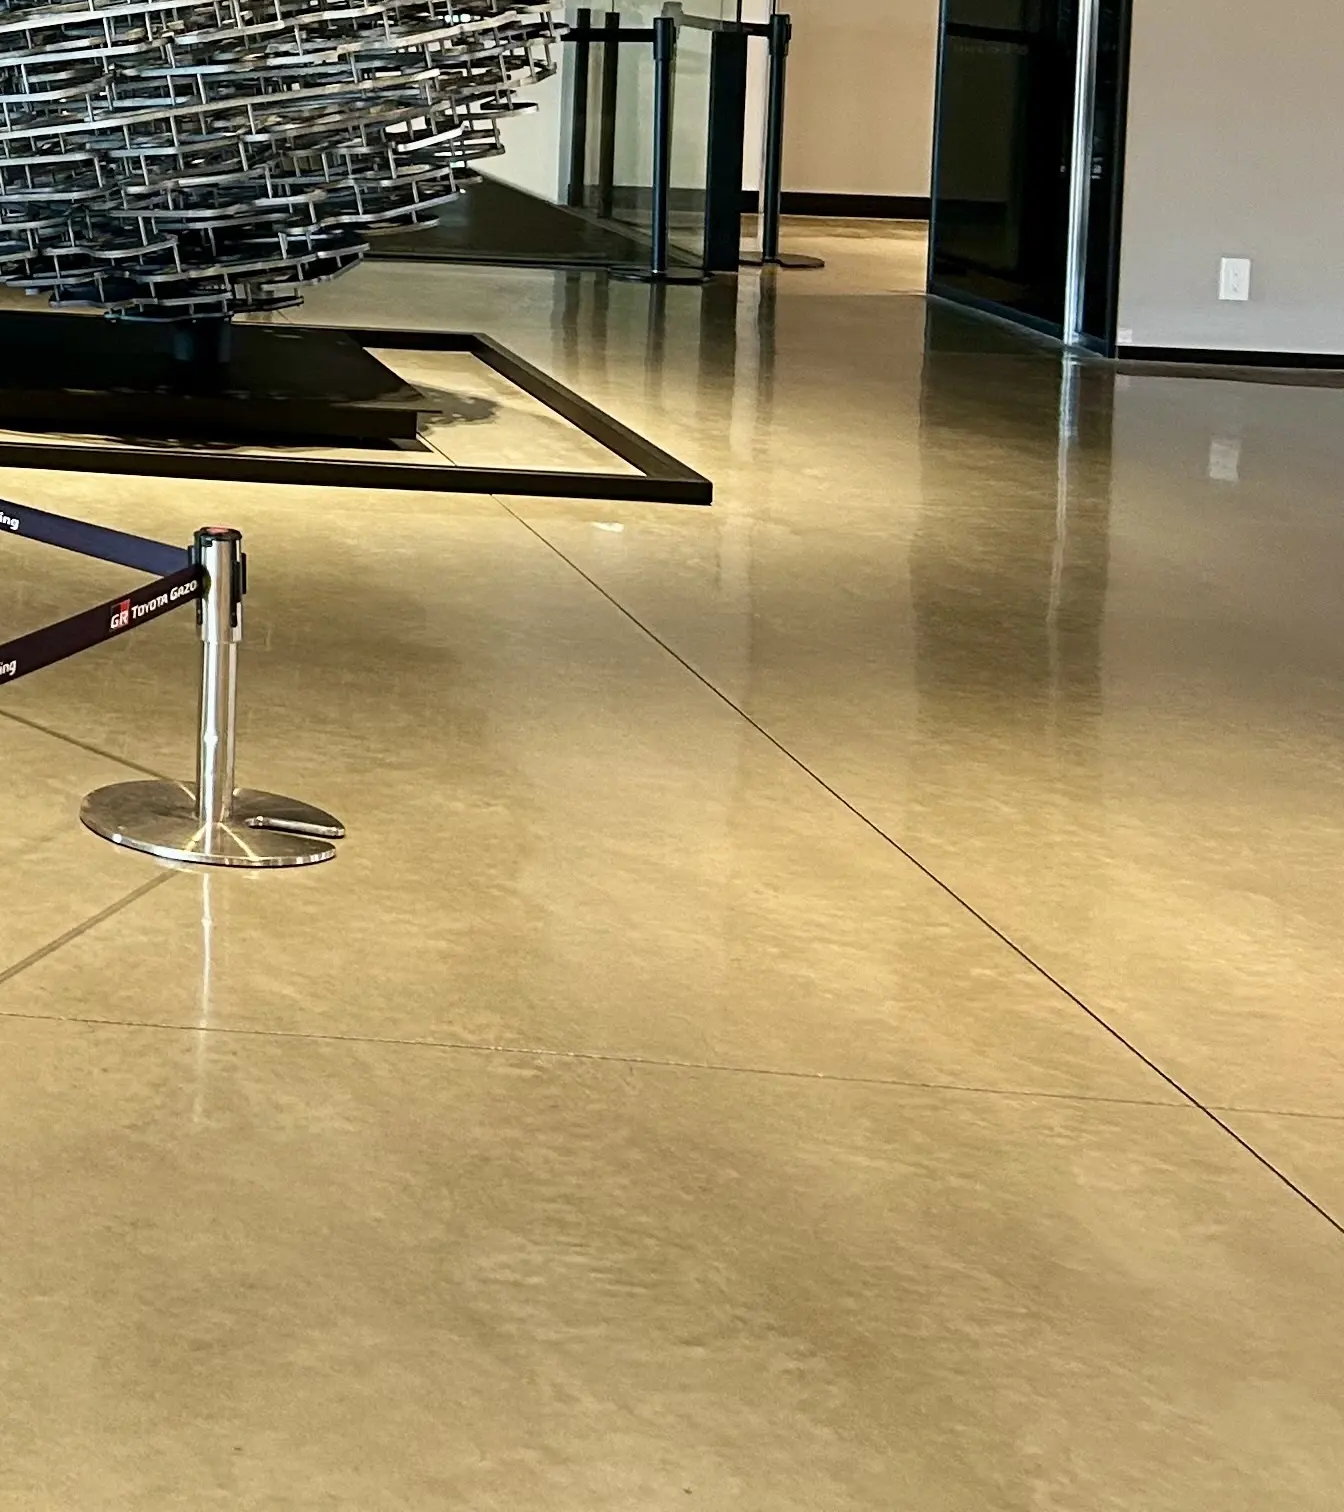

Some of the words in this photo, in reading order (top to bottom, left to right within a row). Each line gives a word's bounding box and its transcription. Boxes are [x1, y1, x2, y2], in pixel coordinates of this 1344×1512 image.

[110, 606, 130, 630] GR
[131, 593, 169, 619] TOYOTA
[169, 580, 198, 601] GAZO
